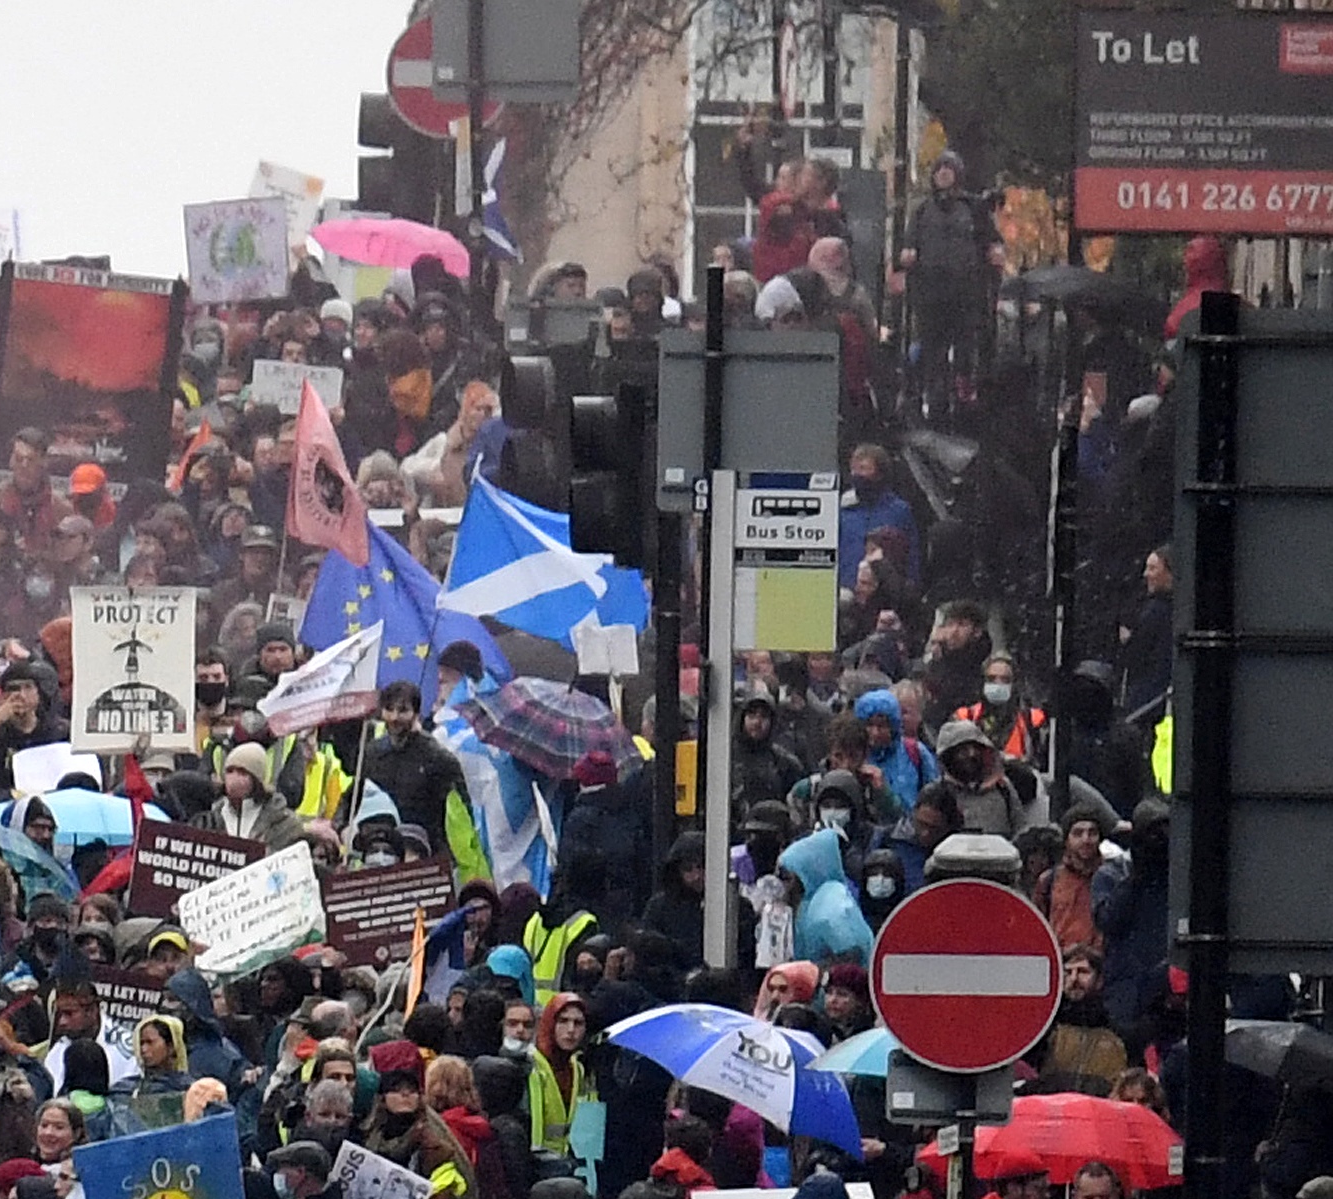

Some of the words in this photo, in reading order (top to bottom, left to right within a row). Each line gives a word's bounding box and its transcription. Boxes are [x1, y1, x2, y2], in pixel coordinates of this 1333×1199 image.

[1092, 31, 1132, 64] To
[1144, 32, 1201, 65] Let
[1118, 182, 1190, 210] 0141
[1202, 184, 1257, 211] 226
[746, 524, 779, 540] Bus
[784, 524, 826, 542] Stop
[93, 604, 179, 624] PROTECT
[137, 850, 191, 873] WORLD
[194, 843, 220, 860] LET
[220, 848, 247, 867] THE
[152, 871, 174, 888] SO
[113, 984, 137, 1000] LET
[737, 1030, 792, 1071] YOU
